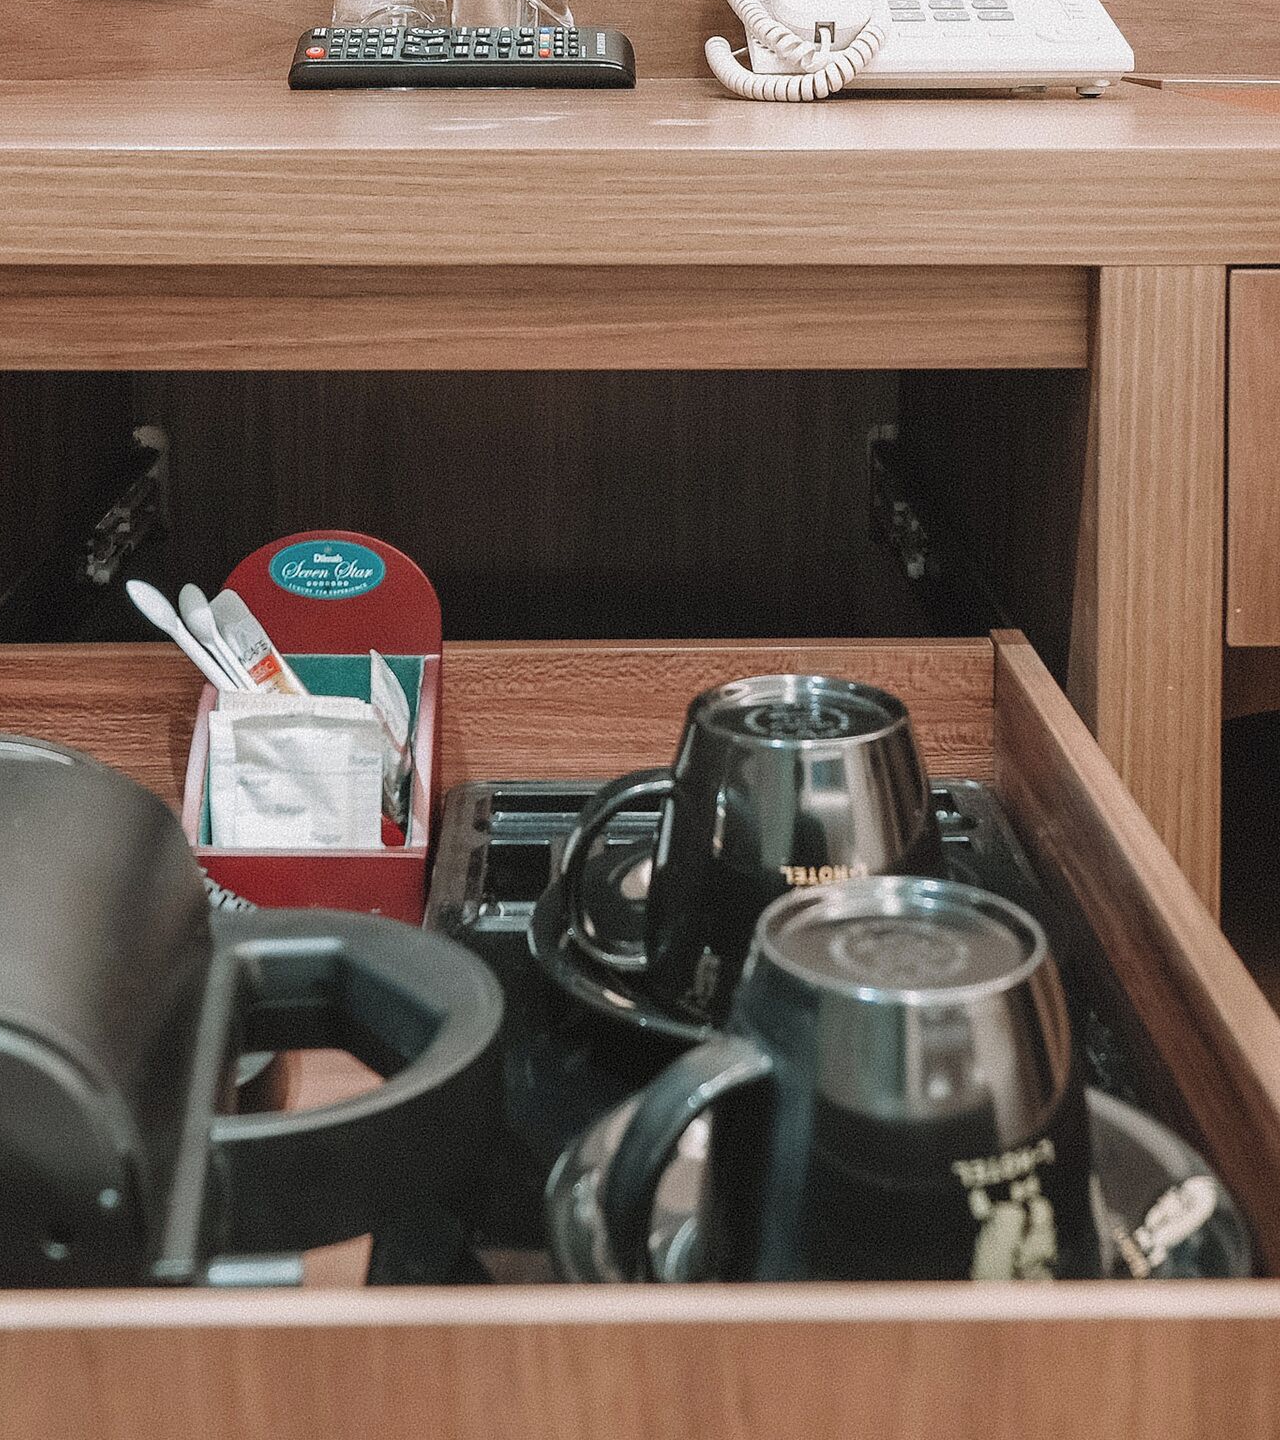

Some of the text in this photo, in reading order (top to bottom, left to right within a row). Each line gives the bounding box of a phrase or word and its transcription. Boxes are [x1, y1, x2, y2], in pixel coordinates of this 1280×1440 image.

[281, 559, 374, 581] Seven Star
[328, 582, 368, 596] EXPERIENCE
[780, 864, 849, 885] HOTEL
